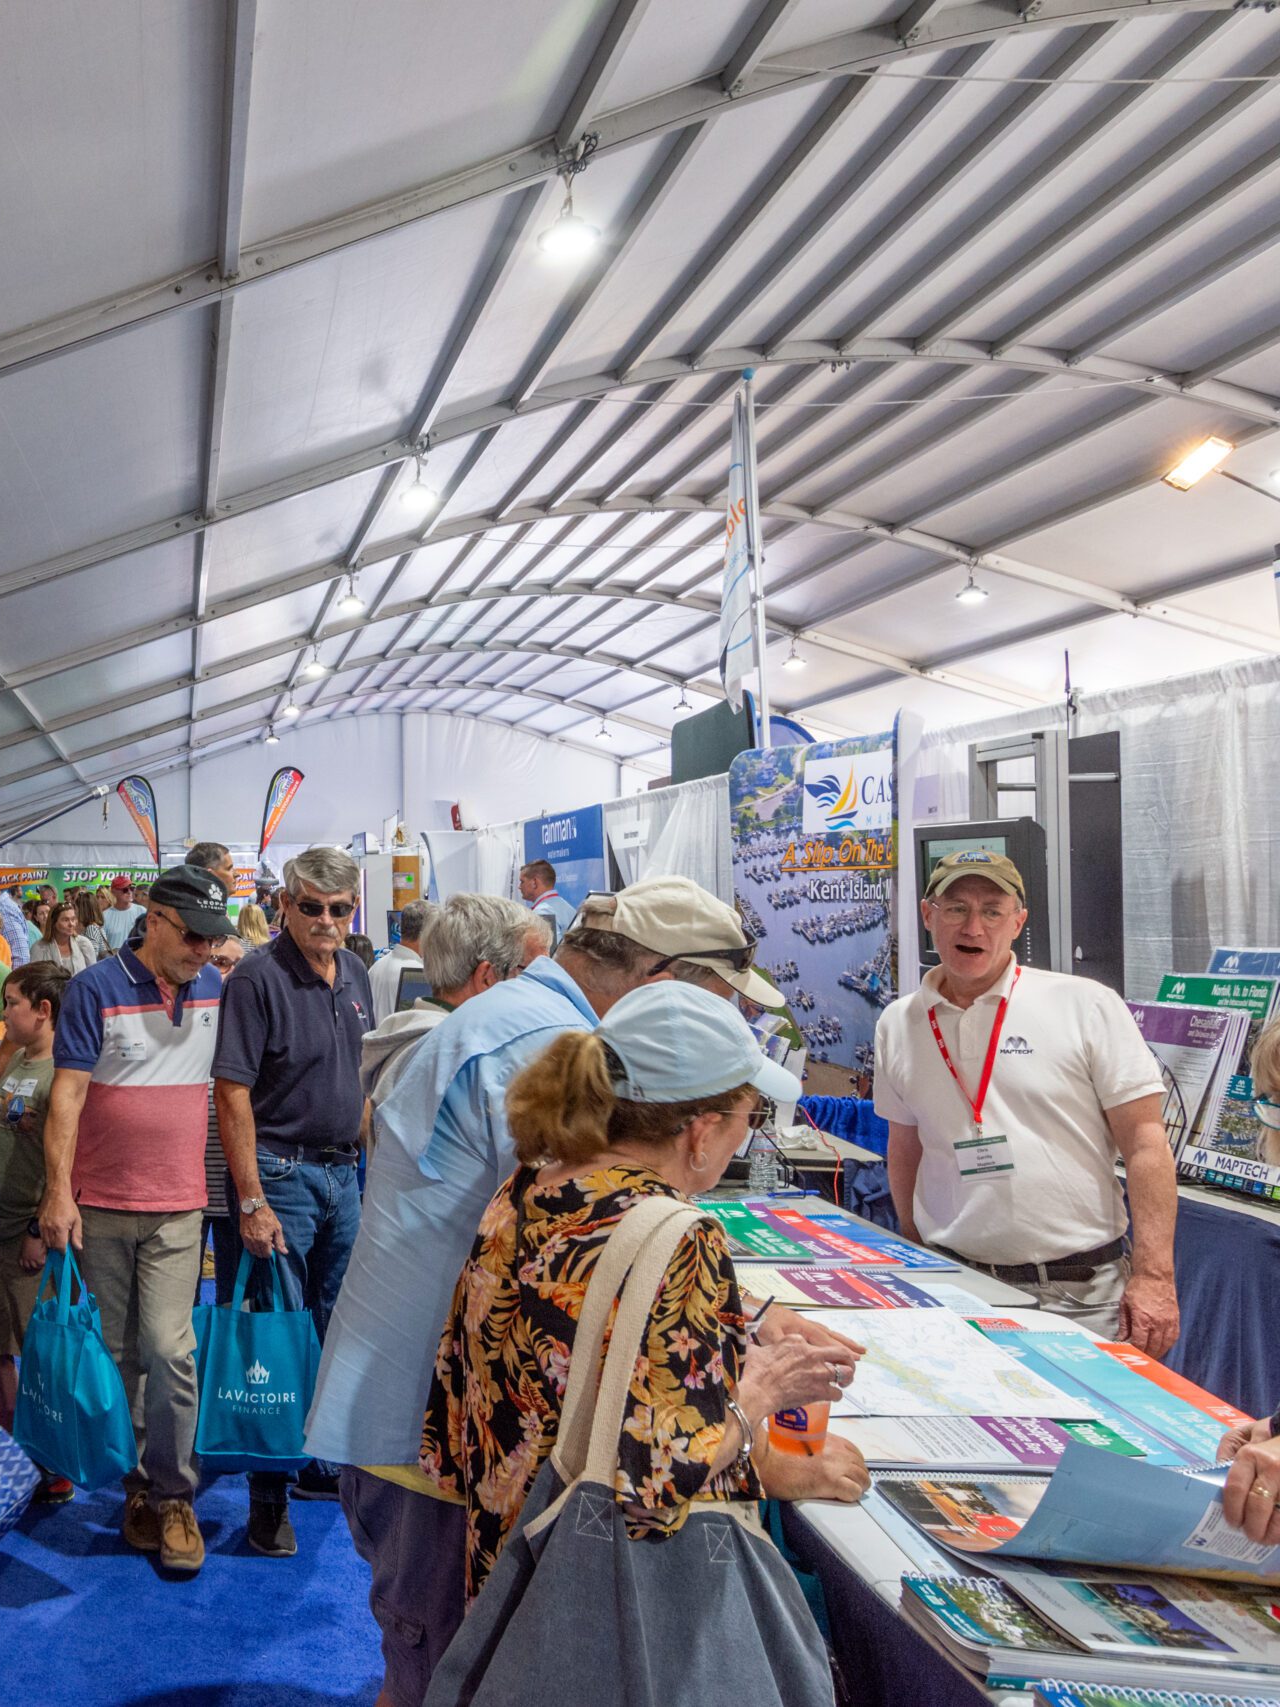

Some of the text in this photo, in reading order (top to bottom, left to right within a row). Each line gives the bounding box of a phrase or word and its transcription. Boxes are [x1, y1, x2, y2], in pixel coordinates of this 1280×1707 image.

[541, 817, 572, 845] rainman
[781, 841, 796, 865] A
[802, 839, 834, 868] Slip
[839, 837, 862, 862] On
[864, 837, 884, 862] The
[21, 870, 49, 881] PAIN?
[63, 870, 98, 882] STOP
[810, 878, 846, 901] Kent
[850, 877, 884, 902] Island,
[1249, 985, 1269, 998] Florida
[1215, 1156, 1269, 1180] MAPTECH
[232, 1404, 281, 1415] FINANCE
[1066, 1422, 1113, 1446] Florida
